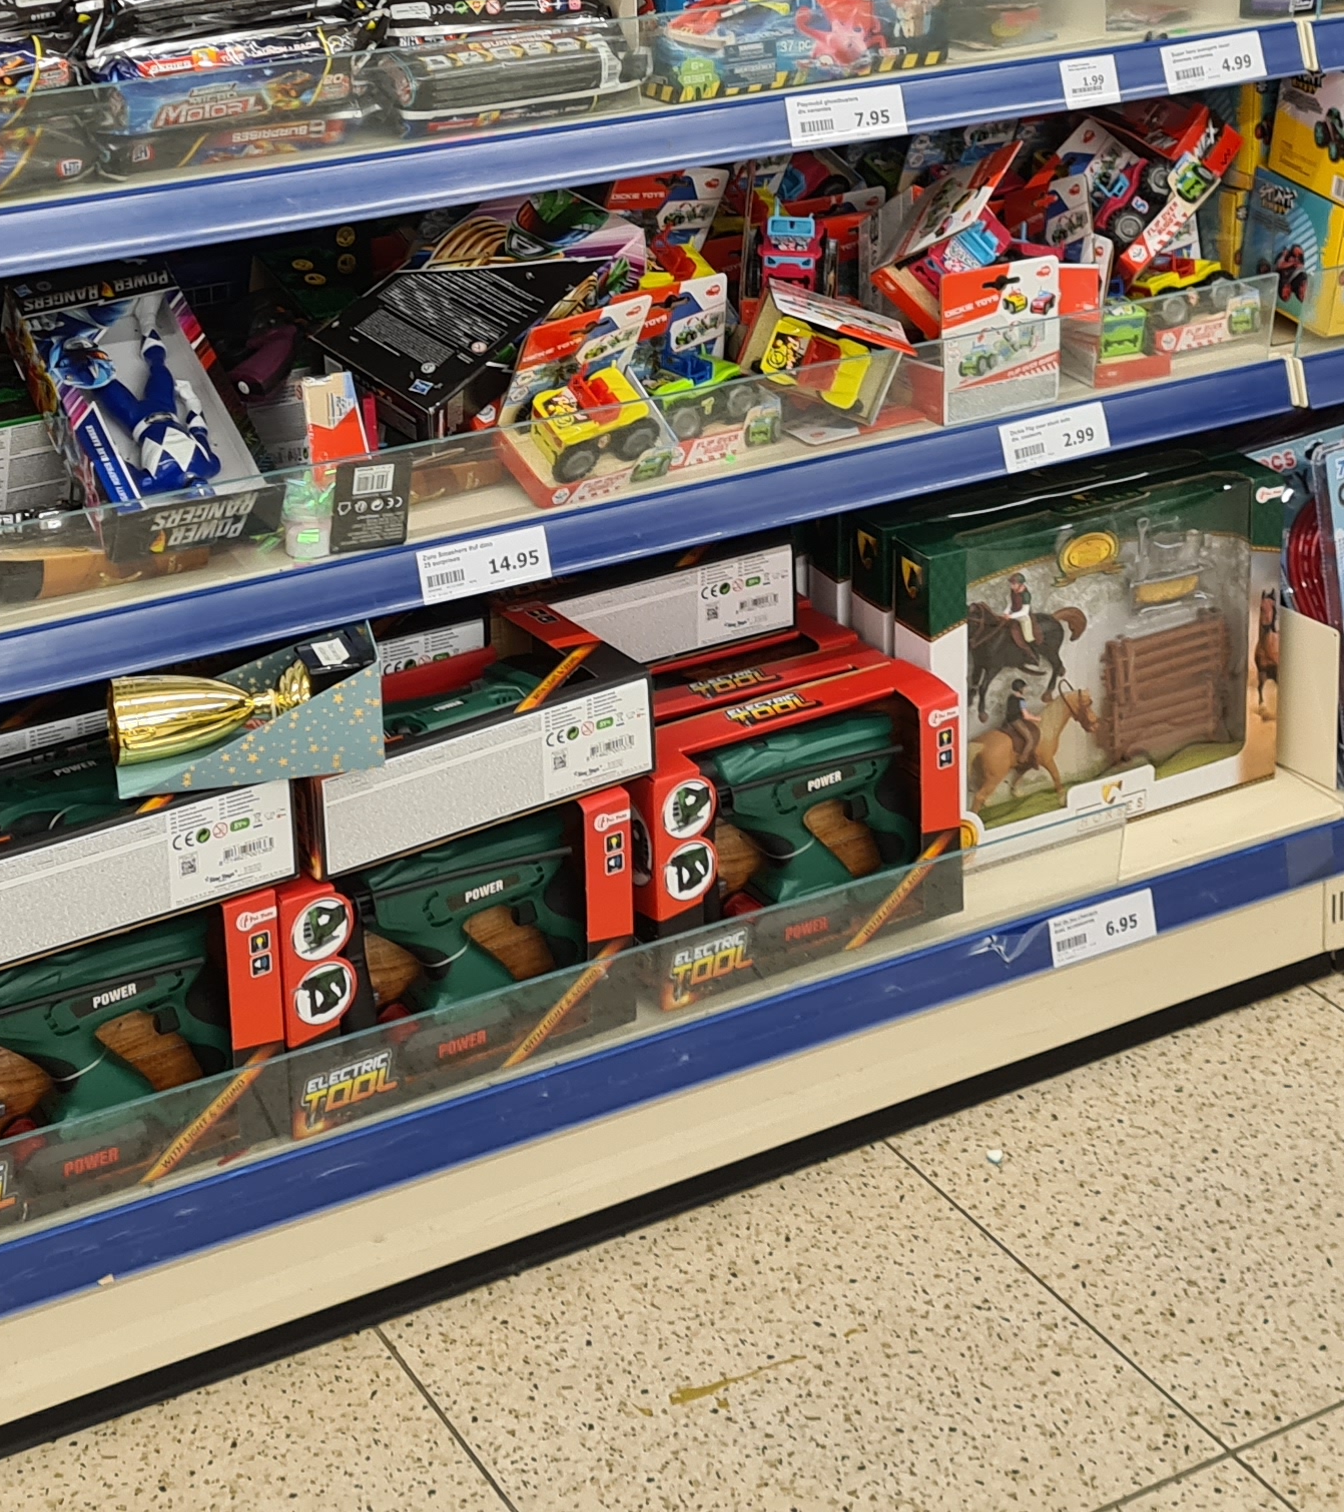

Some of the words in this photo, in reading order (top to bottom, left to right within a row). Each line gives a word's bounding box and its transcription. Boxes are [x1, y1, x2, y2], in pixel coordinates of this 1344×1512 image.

[1221, 54, 1252, 72] 4.99
[1082, 74, 1104, 87] 1.99
[854, 110, 890, 128] 7.95
[115, 271, 169, 292] POWER
[23, 285, 99, 312] RANGERS
[944, 303, 974, 317] DICKIE
[975, 295, 999, 307] TOYS
[1063, 427, 1094, 448] 2.99
[151, 493, 257, 531] RANGERS
[168, 514, 247, 546] POWER
[488, 549, 540, 575] 14.95
[807, 770, 842, 793] POWER
[465, 879, 504, 903] POWER
[1105, 913, 1138, 937] 6.95
[672, 929, 747, 969] ELECTRIC
[670, 945, 753, 985] TOOL
[91, 983, 137, 1008] POWER
[438, 1030, 487, 1058] POWER
[306, 1051, 391, 1093] ELECTRIC
[304, 1069, 398, 1115] TOOL
